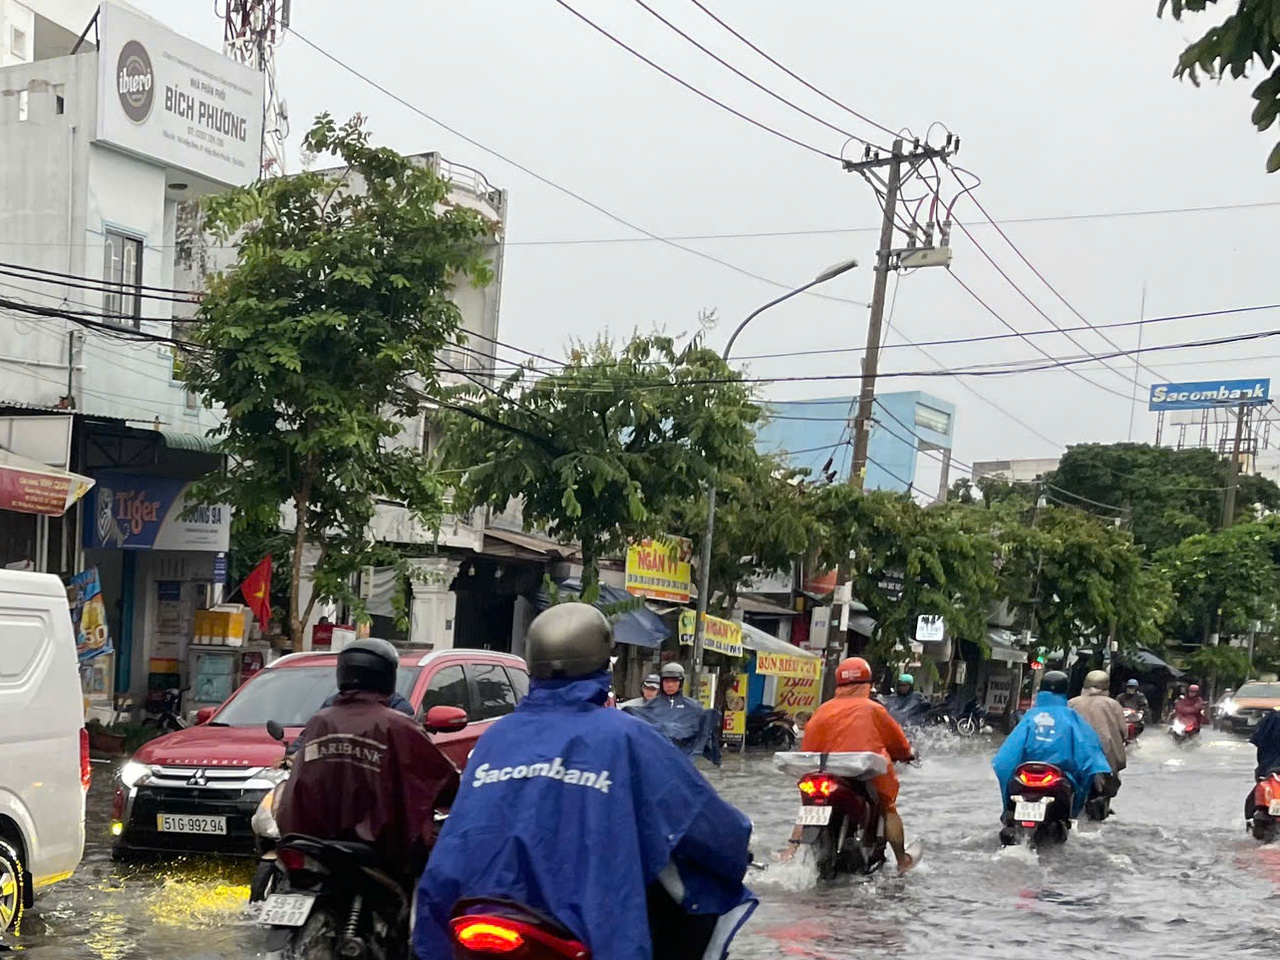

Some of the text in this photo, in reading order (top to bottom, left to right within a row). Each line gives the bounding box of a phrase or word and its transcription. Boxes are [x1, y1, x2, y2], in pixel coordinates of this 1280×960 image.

[165, 84, 194, 121] BÍCH
[199, 100, 247, 143] PHƯƠNG
[116, 491, 160, 534] Tiger
[472, 757, 614, 794] Sacombank
[164, 817, 224, 833] 51G-992.94
